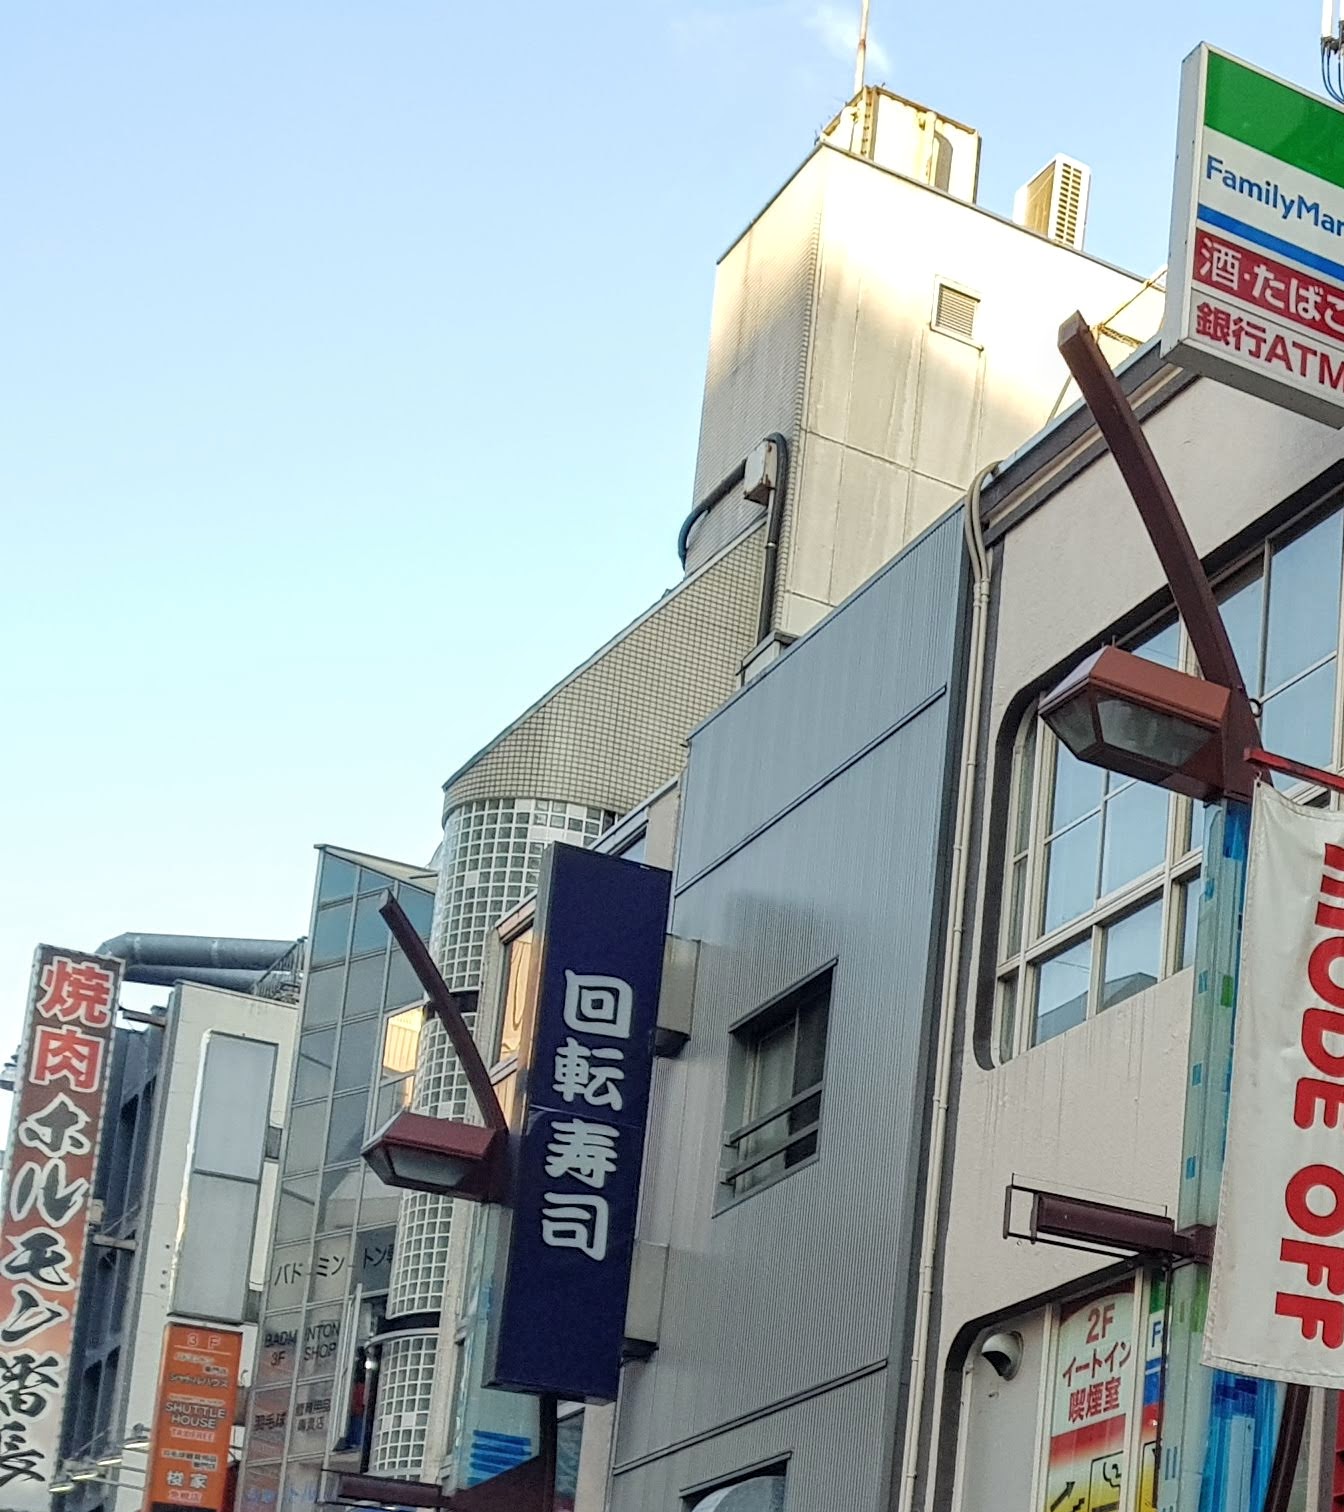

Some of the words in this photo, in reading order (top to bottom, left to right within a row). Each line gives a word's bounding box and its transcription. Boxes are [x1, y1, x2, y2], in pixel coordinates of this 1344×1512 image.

[540, 968, 634, 1262] 回転寿司
[265, 1320, 341, 1348] BADMNTON
[1086, 1303, 1116, 1345] 2F
[1062, 1341, 1132, 1388] イートイン
[165, 1401, 226, 1419] SHUTTLE
[1067, 1376, 1122, 1424] 喫煙室
[171, 1414, 217, 1429] HOUSE
